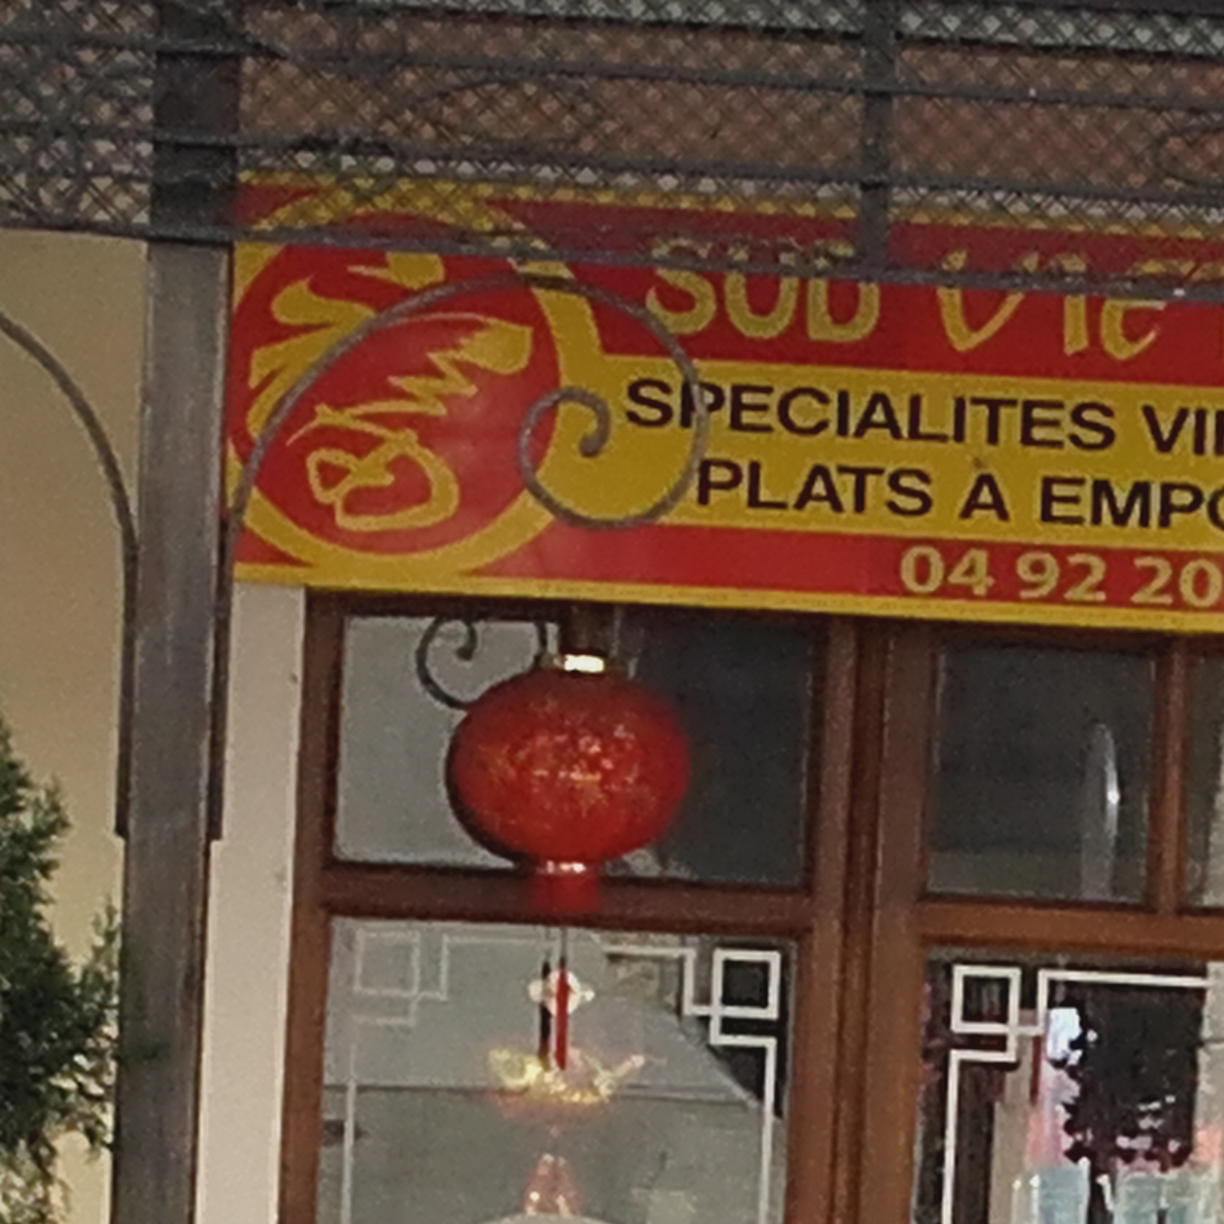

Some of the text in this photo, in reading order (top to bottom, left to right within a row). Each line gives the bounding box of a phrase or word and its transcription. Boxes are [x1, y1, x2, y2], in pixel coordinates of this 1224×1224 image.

[647, 236, 881, 342] SUD
[626, 378, 1116, 450] SPECIALITES
[699, 460, 932, 517] PLATS
[900, 546, 994, 597] 04
[1017, 551, 1107, 602] 92
[1131, 558, 1224, 609] 20
